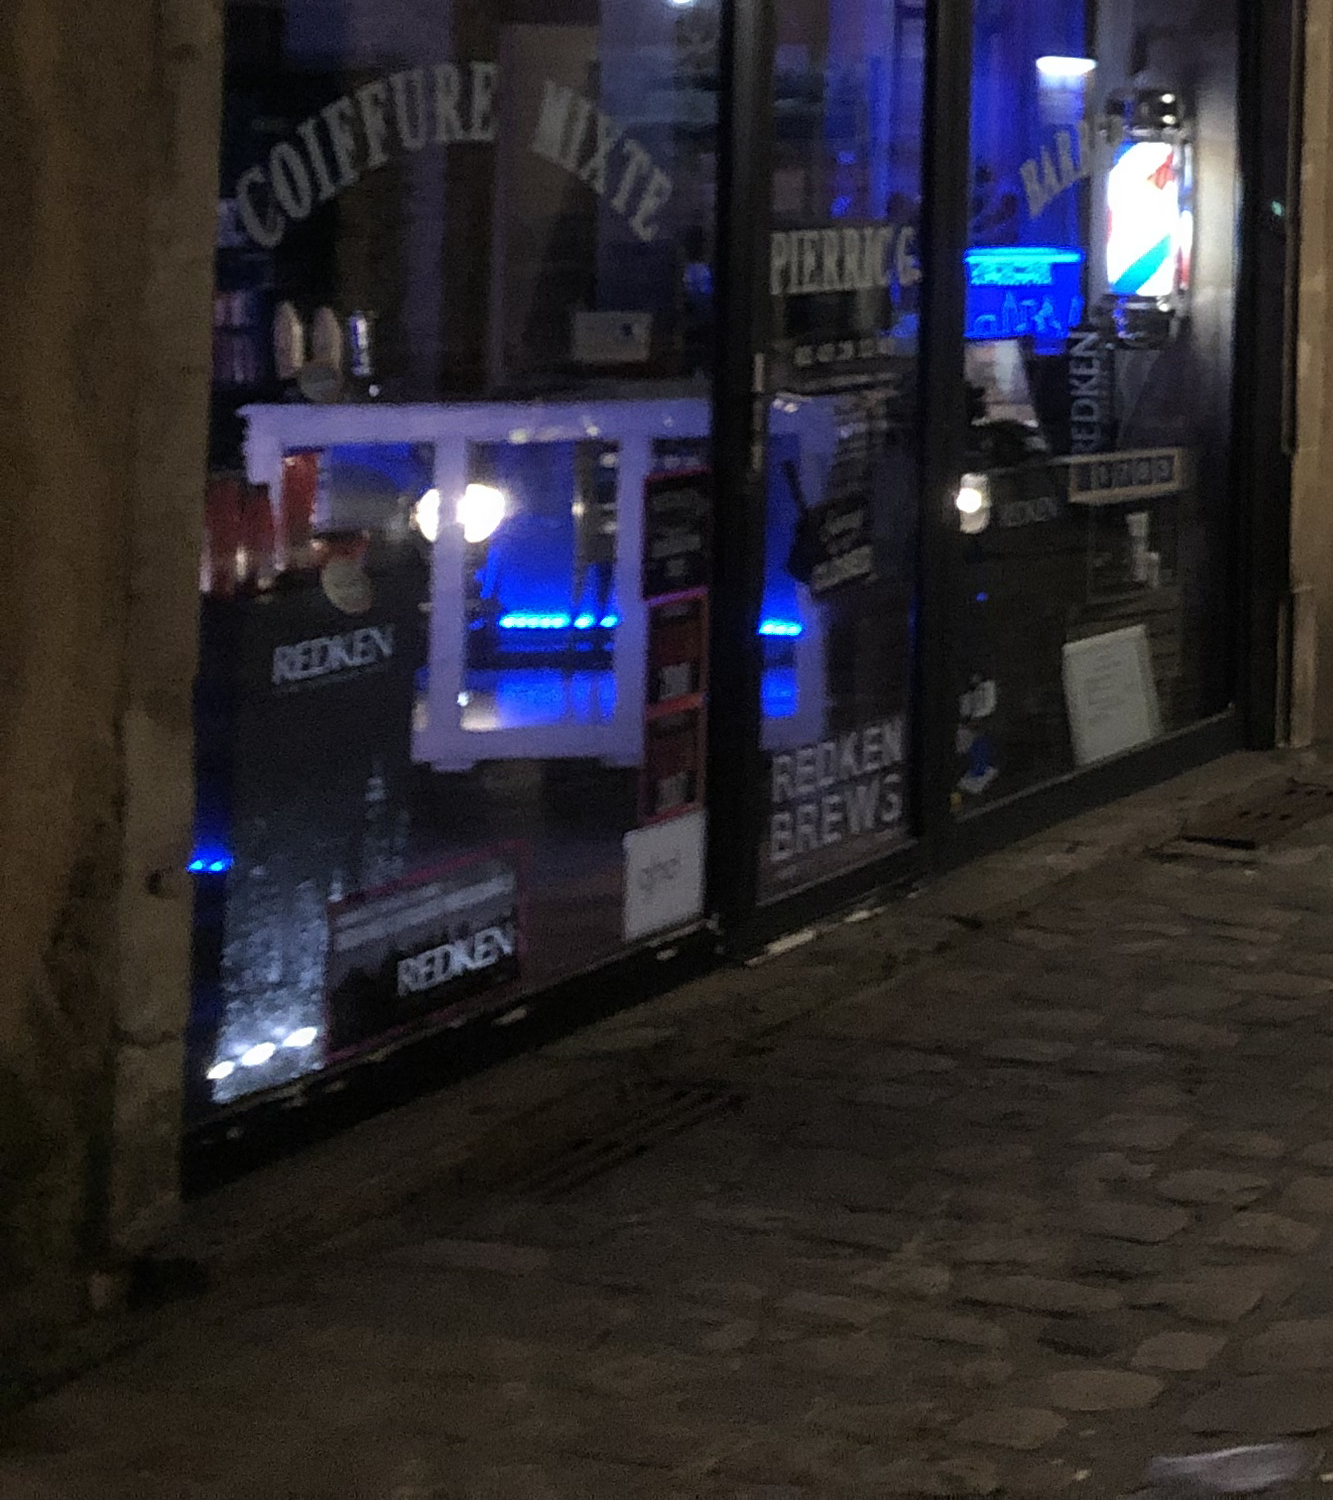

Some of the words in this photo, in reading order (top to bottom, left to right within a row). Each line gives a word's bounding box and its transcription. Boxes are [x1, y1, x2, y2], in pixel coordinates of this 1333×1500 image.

[236, 60, 500, 249] COIFFURE
[532, 79, 674, 242] MIXTE
[769, 226, 893, 296] PIERRIC
[271, 622, 395, 687] REDKEN
[771, 714, 905, 804] REDKEN
[770, 771, 904, 863] BREWS
[396, 925, 515, 998] REDKEN
